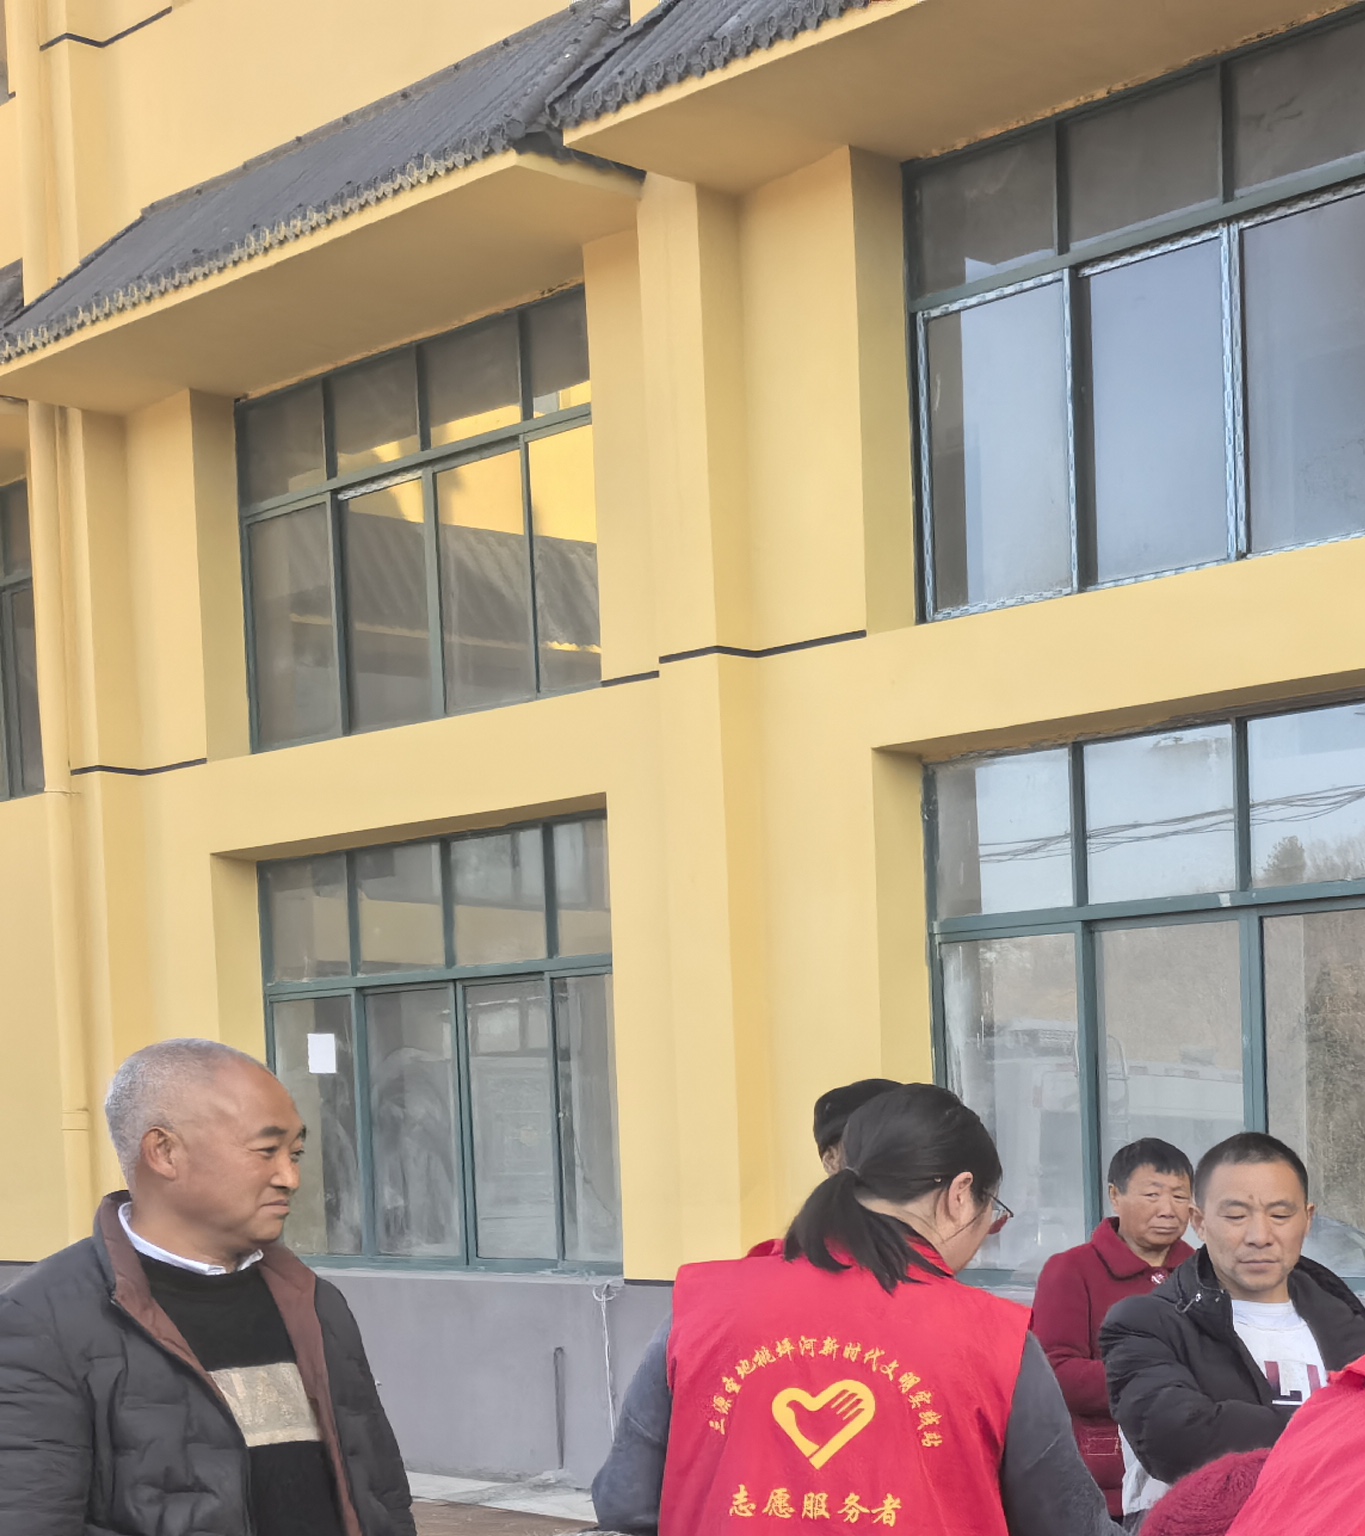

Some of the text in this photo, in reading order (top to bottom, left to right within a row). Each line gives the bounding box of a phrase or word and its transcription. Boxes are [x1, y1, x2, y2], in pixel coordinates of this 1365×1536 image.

[729, 1484, 902, 1527] 志愿服务者
